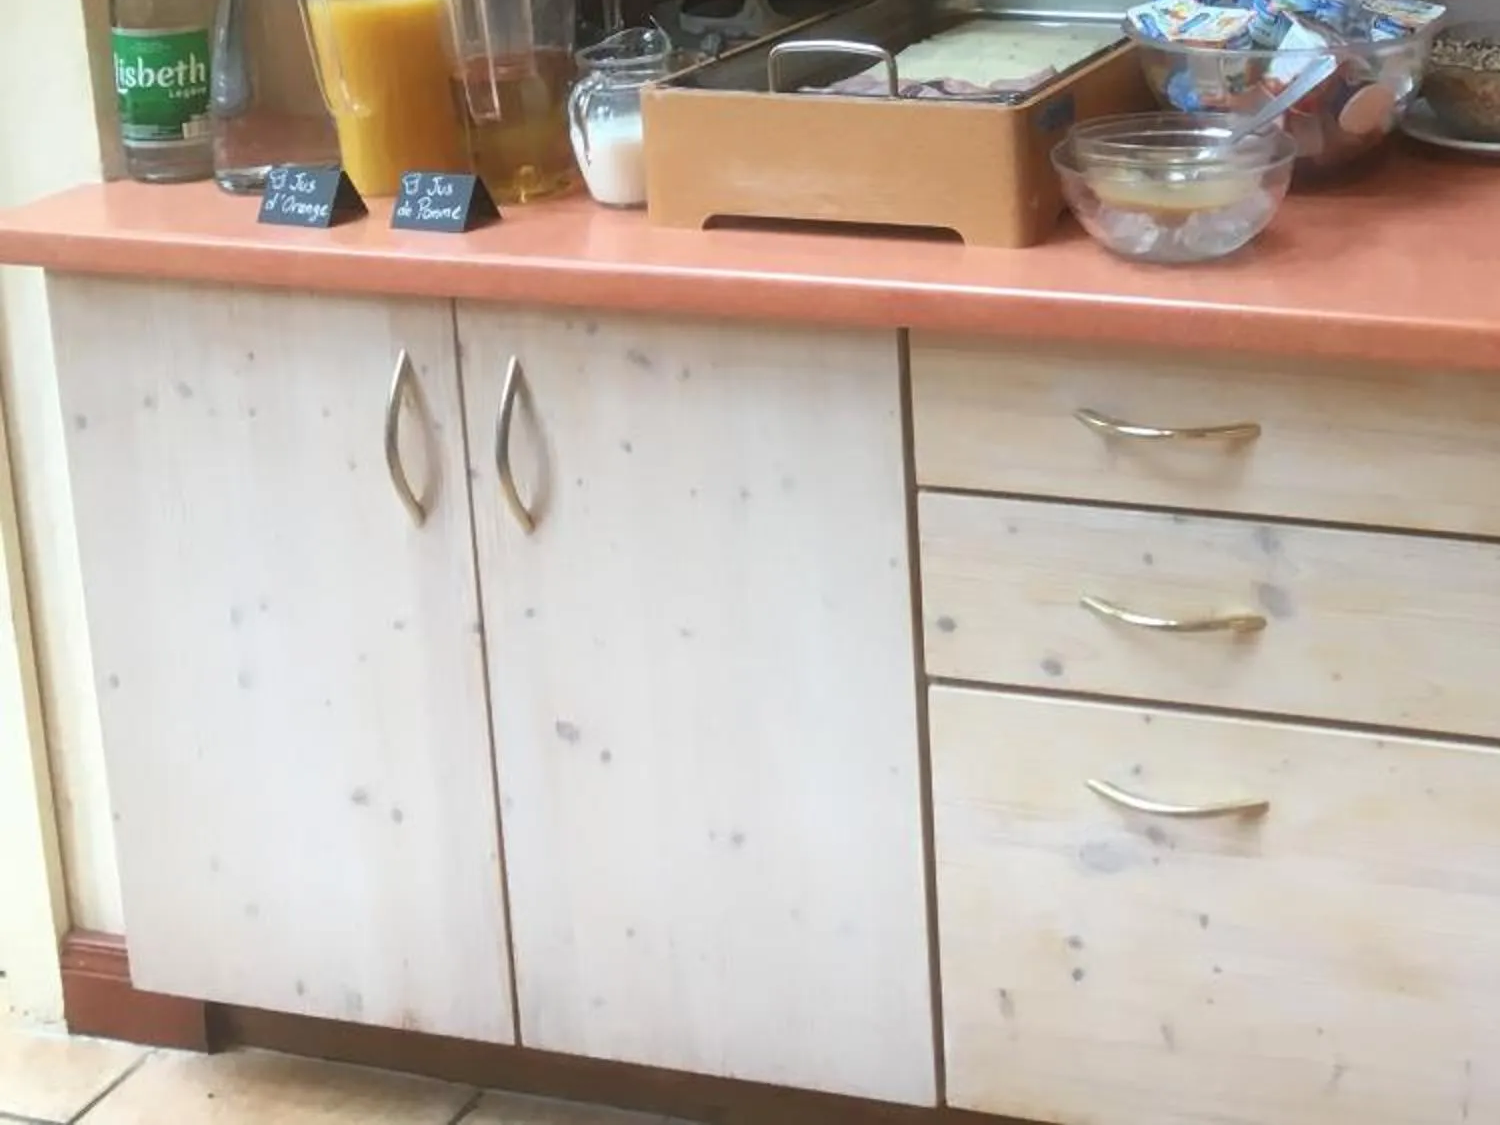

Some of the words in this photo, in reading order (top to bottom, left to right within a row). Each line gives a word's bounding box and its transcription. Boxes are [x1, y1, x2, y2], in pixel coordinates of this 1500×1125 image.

[113, 51, 206, 94] Lisbeth
[289, 172, 317, 194] Jus
[426, 175, 454, 197] Jus
[264, 192, 330, 223] d'Orange
[396, 203, 413, 217] de
